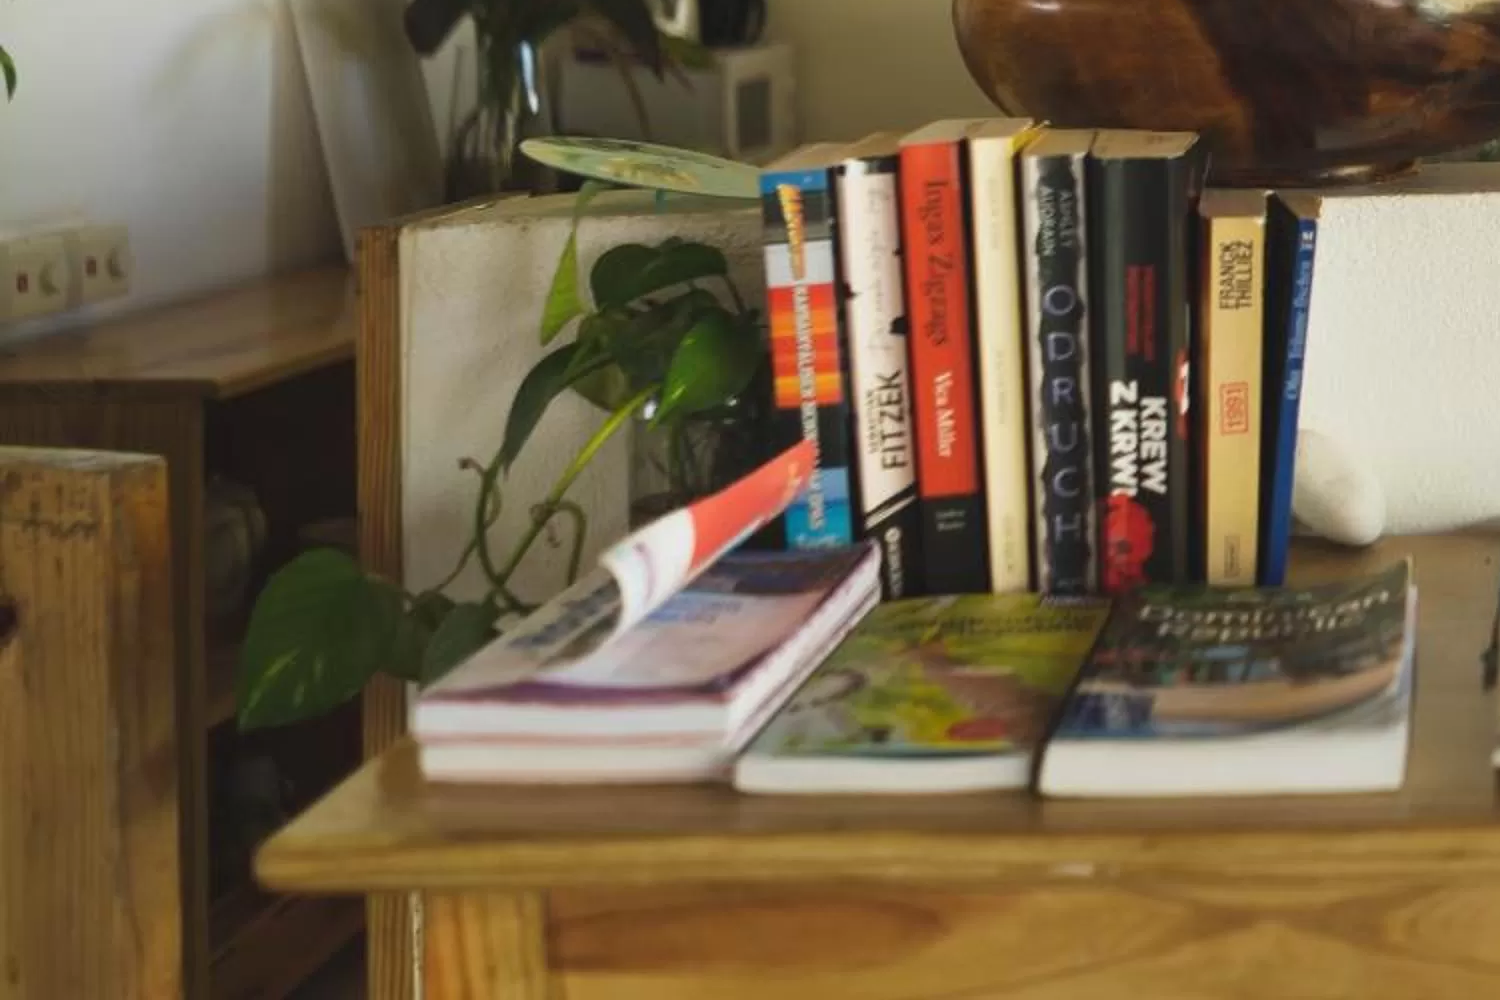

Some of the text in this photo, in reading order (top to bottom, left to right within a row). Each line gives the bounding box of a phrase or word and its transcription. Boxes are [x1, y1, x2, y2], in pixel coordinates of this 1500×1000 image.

[876, 369, 909, 471] FITZEK
[1043, 284, 1082, 542] ODRUCH
[1110, 379, 1138, 405] Z
[1140, 396, 1168, 495] KREW
